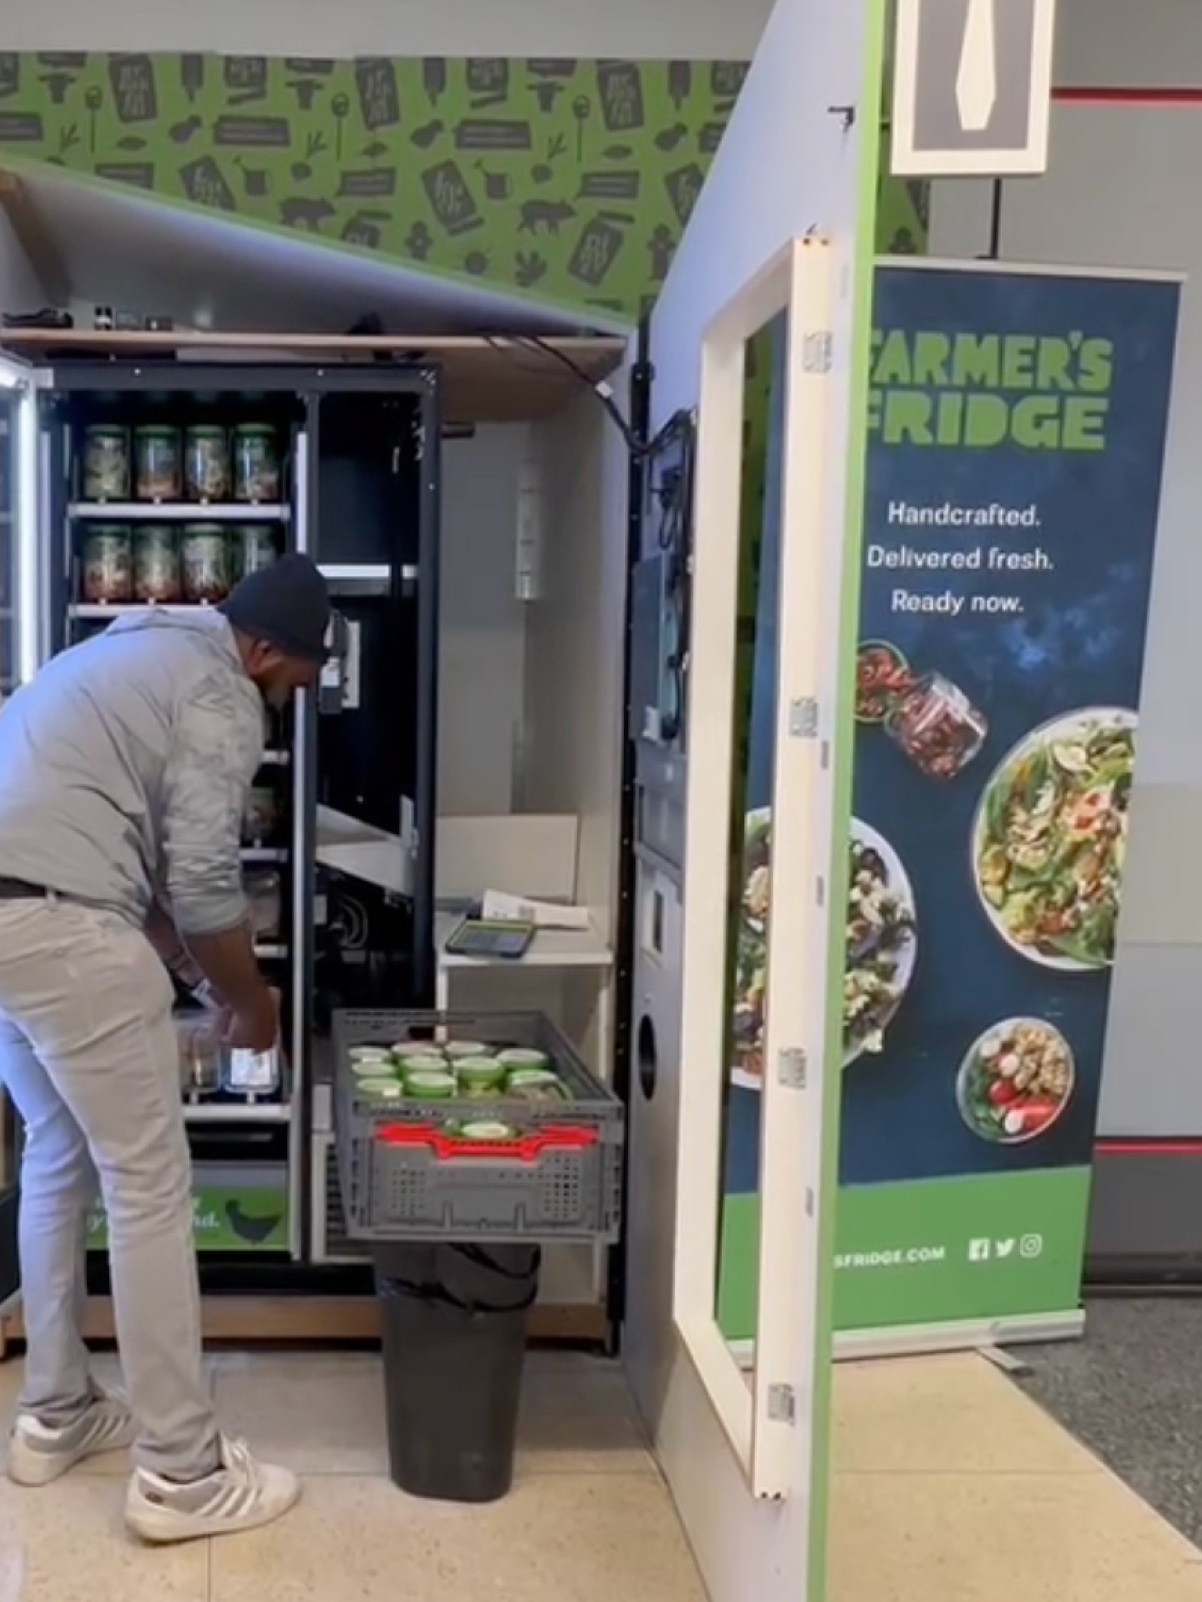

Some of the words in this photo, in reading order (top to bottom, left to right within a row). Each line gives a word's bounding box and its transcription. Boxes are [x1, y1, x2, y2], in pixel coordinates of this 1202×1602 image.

[888, 501, 1041, 526] Handcrafted.
[867, 545, 980, 569] Delivered
[988, 547, 1054, 569] fresh.
[891, 589, 964, 616] Ready
[971, 594, 1024, 612] now.
